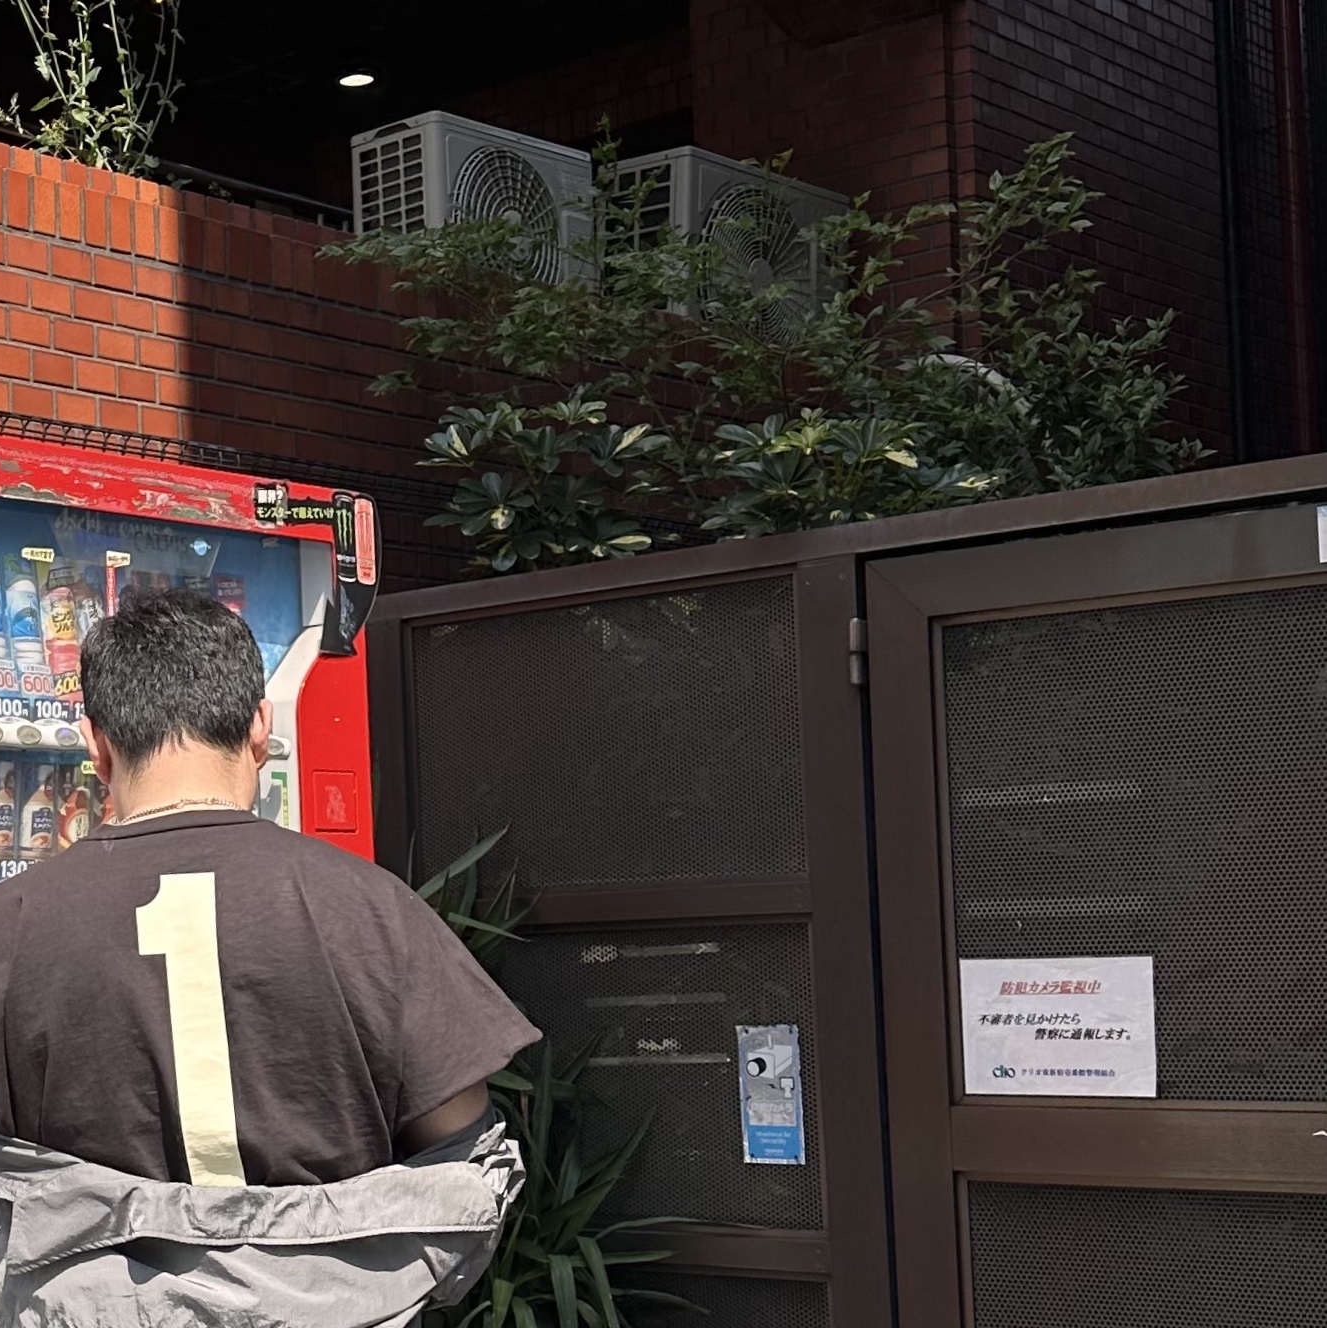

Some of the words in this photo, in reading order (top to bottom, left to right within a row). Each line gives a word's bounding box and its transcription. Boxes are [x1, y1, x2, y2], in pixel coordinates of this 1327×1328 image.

[35, 700, 68, 718] 100円
[999, 979, 1102, 995] 防犯カメラ監視中
[978, 1012, 1081, 1026] 不審者を見かけたら
[135, 871, 247, 1187] 1
[1034, 1027, 1132, 1041] 警察に通報します。
